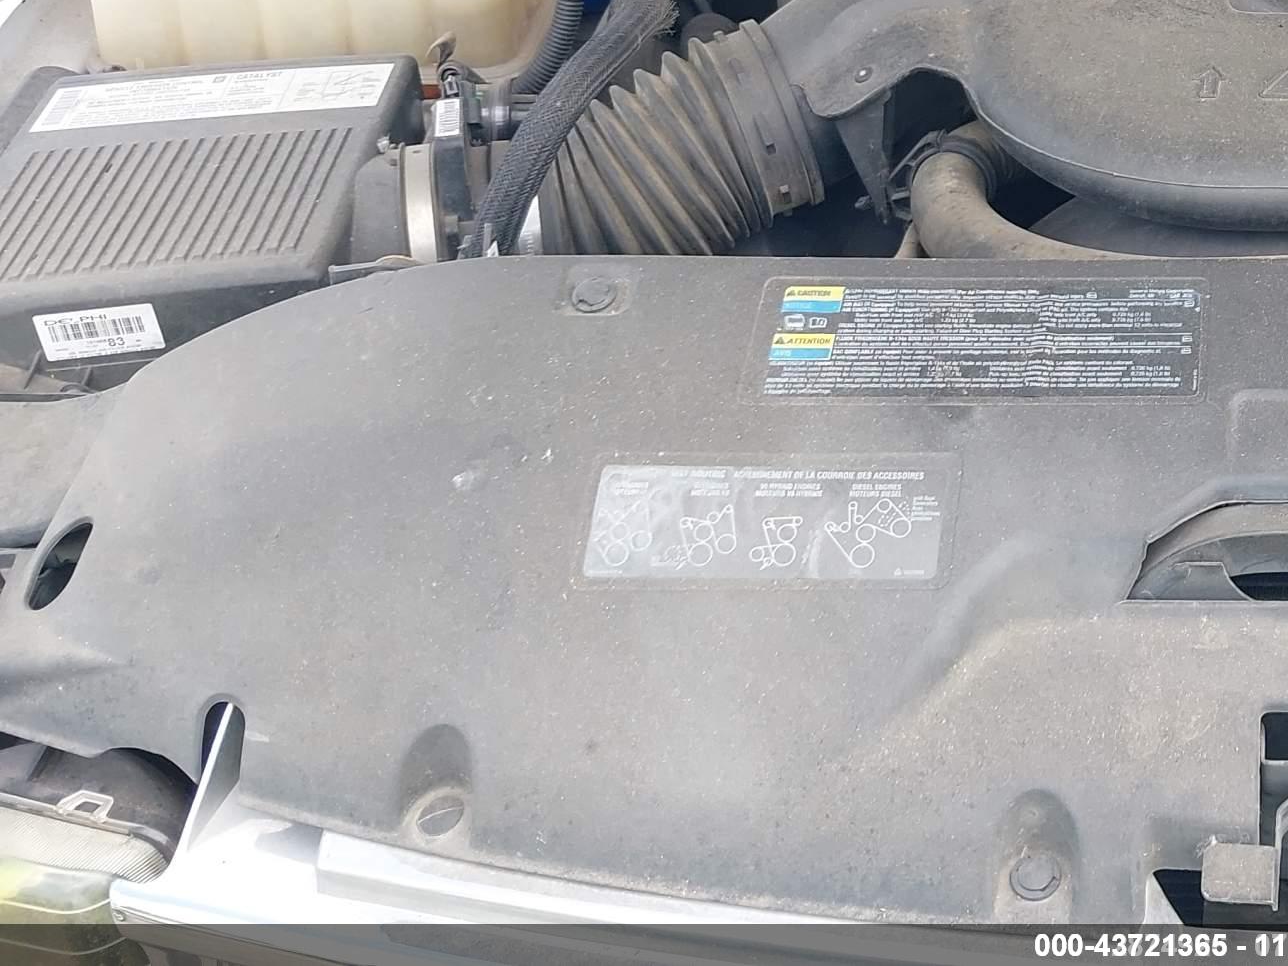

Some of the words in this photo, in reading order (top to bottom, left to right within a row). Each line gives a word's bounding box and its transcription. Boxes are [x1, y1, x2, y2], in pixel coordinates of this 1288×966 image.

[107, 337, 126, 347] 83
[786, 337, 832, 345] ATTENTION
[873, 472, 925, 480] ACCESSOIRES
